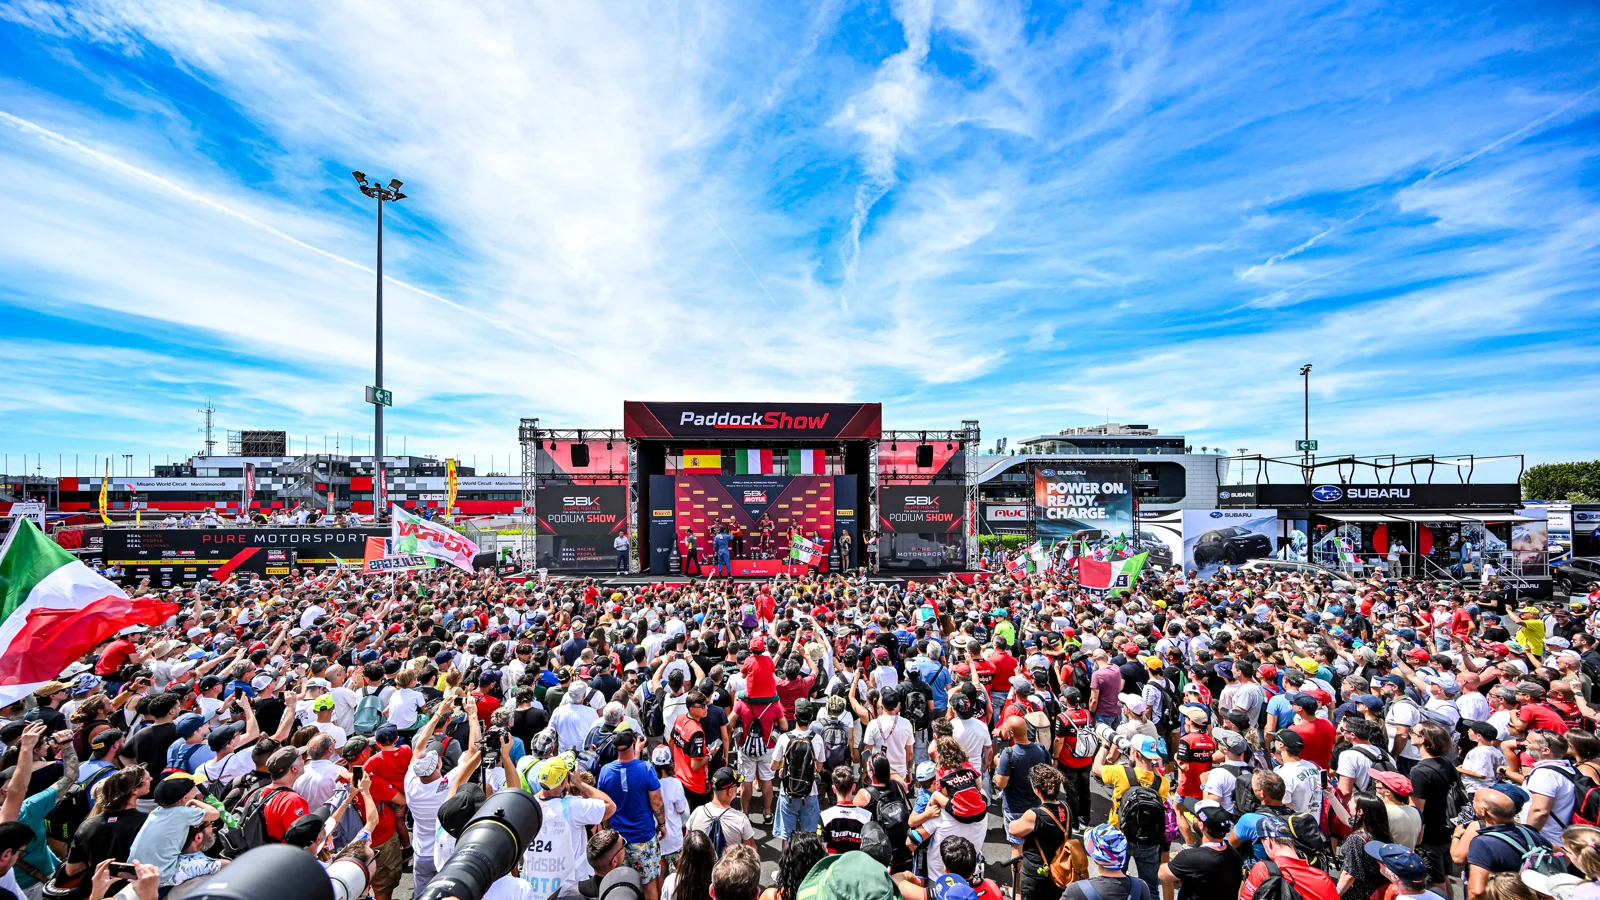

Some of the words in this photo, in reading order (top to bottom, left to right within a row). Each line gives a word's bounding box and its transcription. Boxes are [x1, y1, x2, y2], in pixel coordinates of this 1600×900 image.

[680, 411, 829, 429] PaddockShow
[1047, 482, 1100, 494] POWER
[1102, 482, 1128, 494] ON.
[1347, 488, 1410, 498] SUBARU
[563, 496, 600, 506] SBK
[904, 496, 940, 505] SBK
[1047, 495, 1098, 506] READY.
[1046, 508, 1110, 519] CHARGE.
[202, 534, 246, 543] PURE
[254, 533, 367, 543] MOTORSPORT
[528, 840, 552, 852] 224
[526, 857, 565, 872] rldSBK
